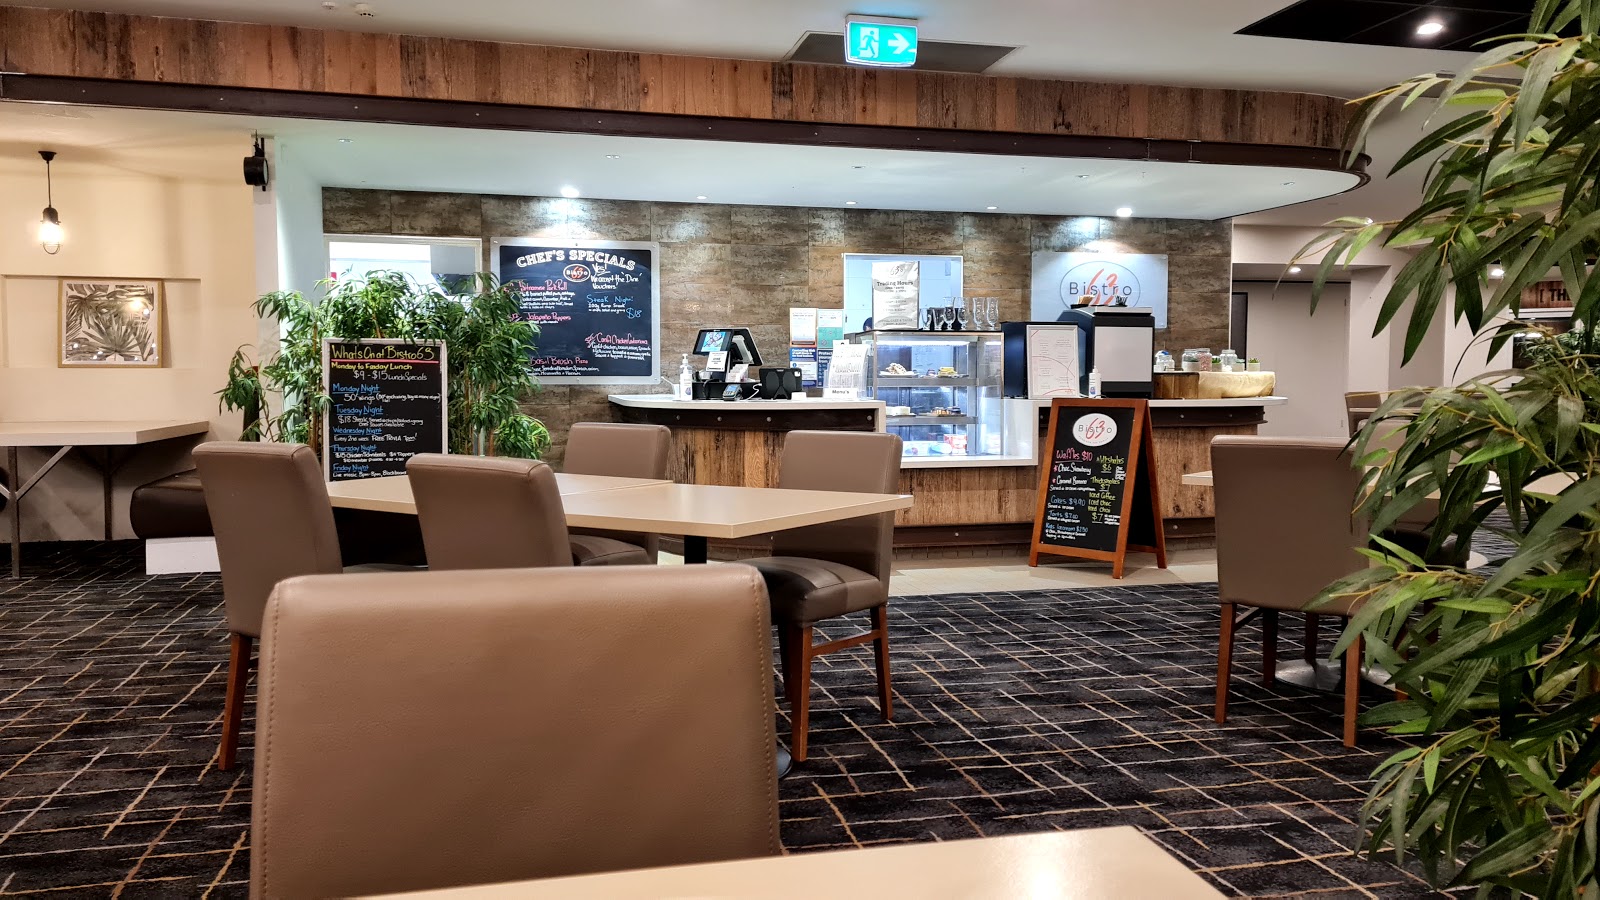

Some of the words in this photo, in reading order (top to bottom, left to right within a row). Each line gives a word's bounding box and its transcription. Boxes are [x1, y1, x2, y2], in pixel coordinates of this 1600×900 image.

[516, 250, 565, 267] CHEF'S
[569, 250, 635, 270] SPECIALS
[1069, 281, 1133, 296] Bistro
[626, 307, 642, 319] $18
[331, 362, 356, 371] Monday
[390, 362, 412, 370] Lunch
[353, 370, 365, 380] $9
[332, 383, 359, 393] Monday
[360, 384, 380, 395] Night
[334, 404, 362, 414] Tuesday
[363, 405, 383, 416] Night
[338, 415, 352, 424] $18
[333, 427, 365, 435] Wednesday
[366, 427, 382, 436] Night
[331, 444, 360, 453] Thursday
[361, 444, 377, 453] Night
[1081, 450, 1093, 462] $10
[333, 463, 351, 472] Friday
[352, 464, 369, 473] Night
[1091, 512, 1104, 521] $7
